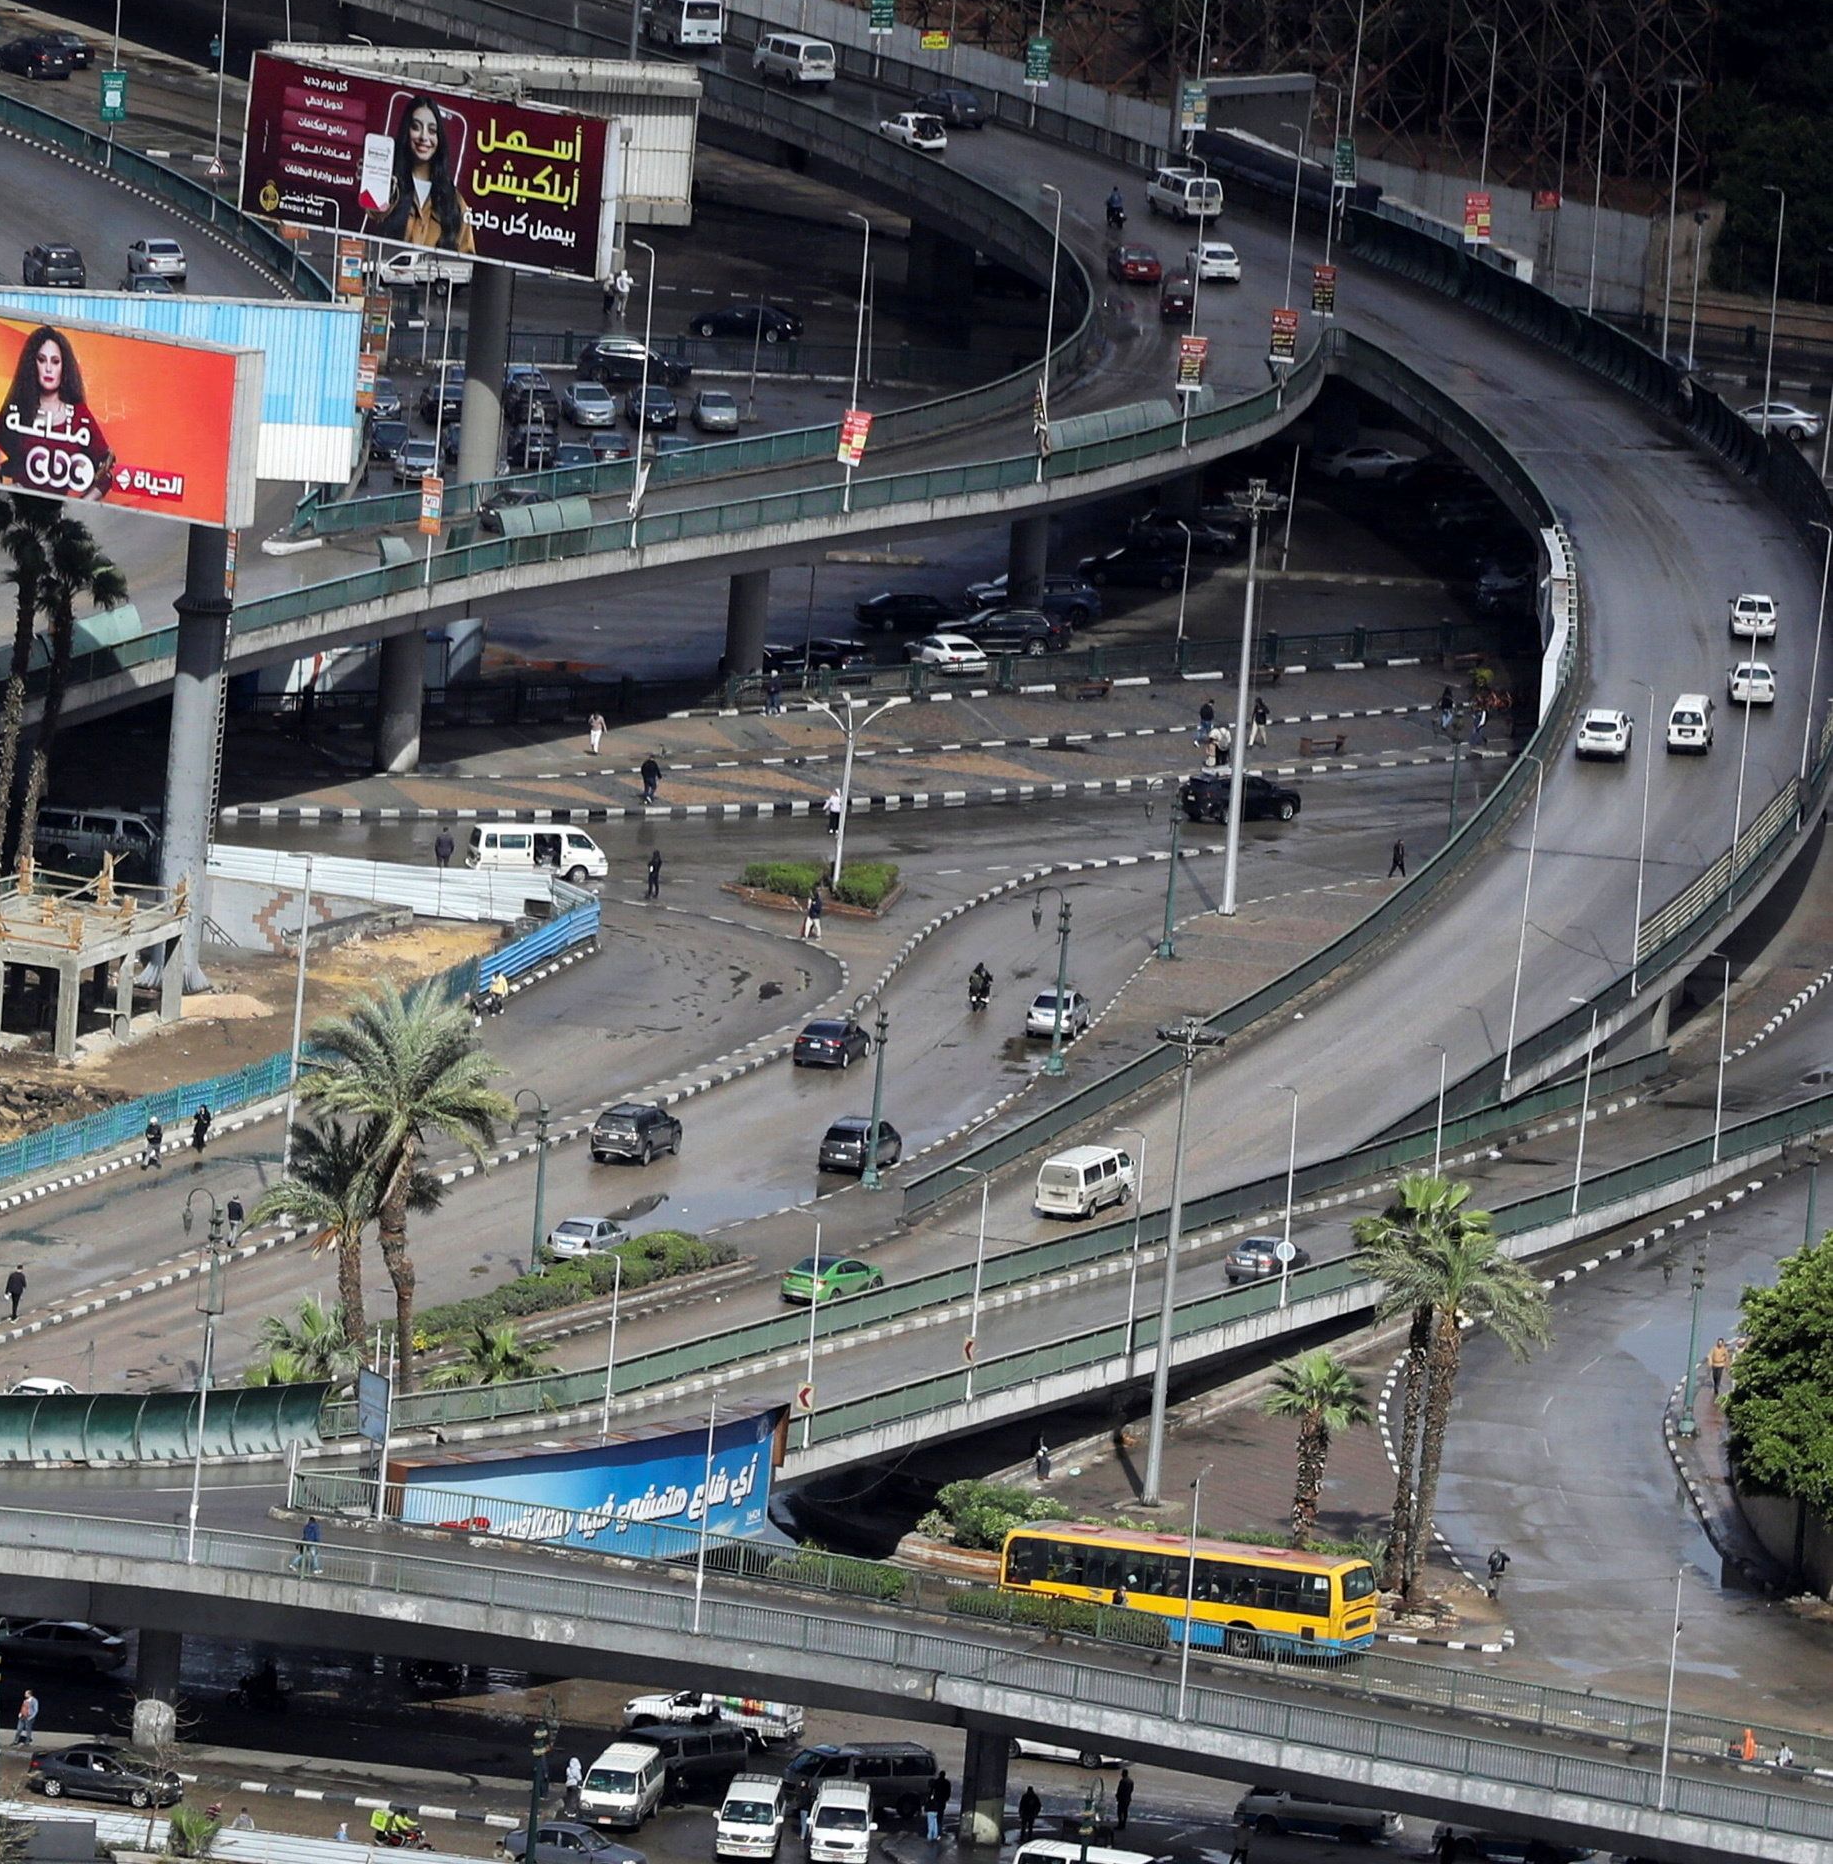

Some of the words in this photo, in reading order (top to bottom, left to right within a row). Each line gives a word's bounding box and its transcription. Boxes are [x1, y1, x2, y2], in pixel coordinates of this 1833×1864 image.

[476, 118, 582, 163] أسهل
[471, 159, 580, 212] أبلكيشن
[463, 207, 500, 232] حاجة
[502, 214, 528, 237] كل
[529, 220, 576, 248] بيعمل
[133, 470, 183, 496] الحياة
